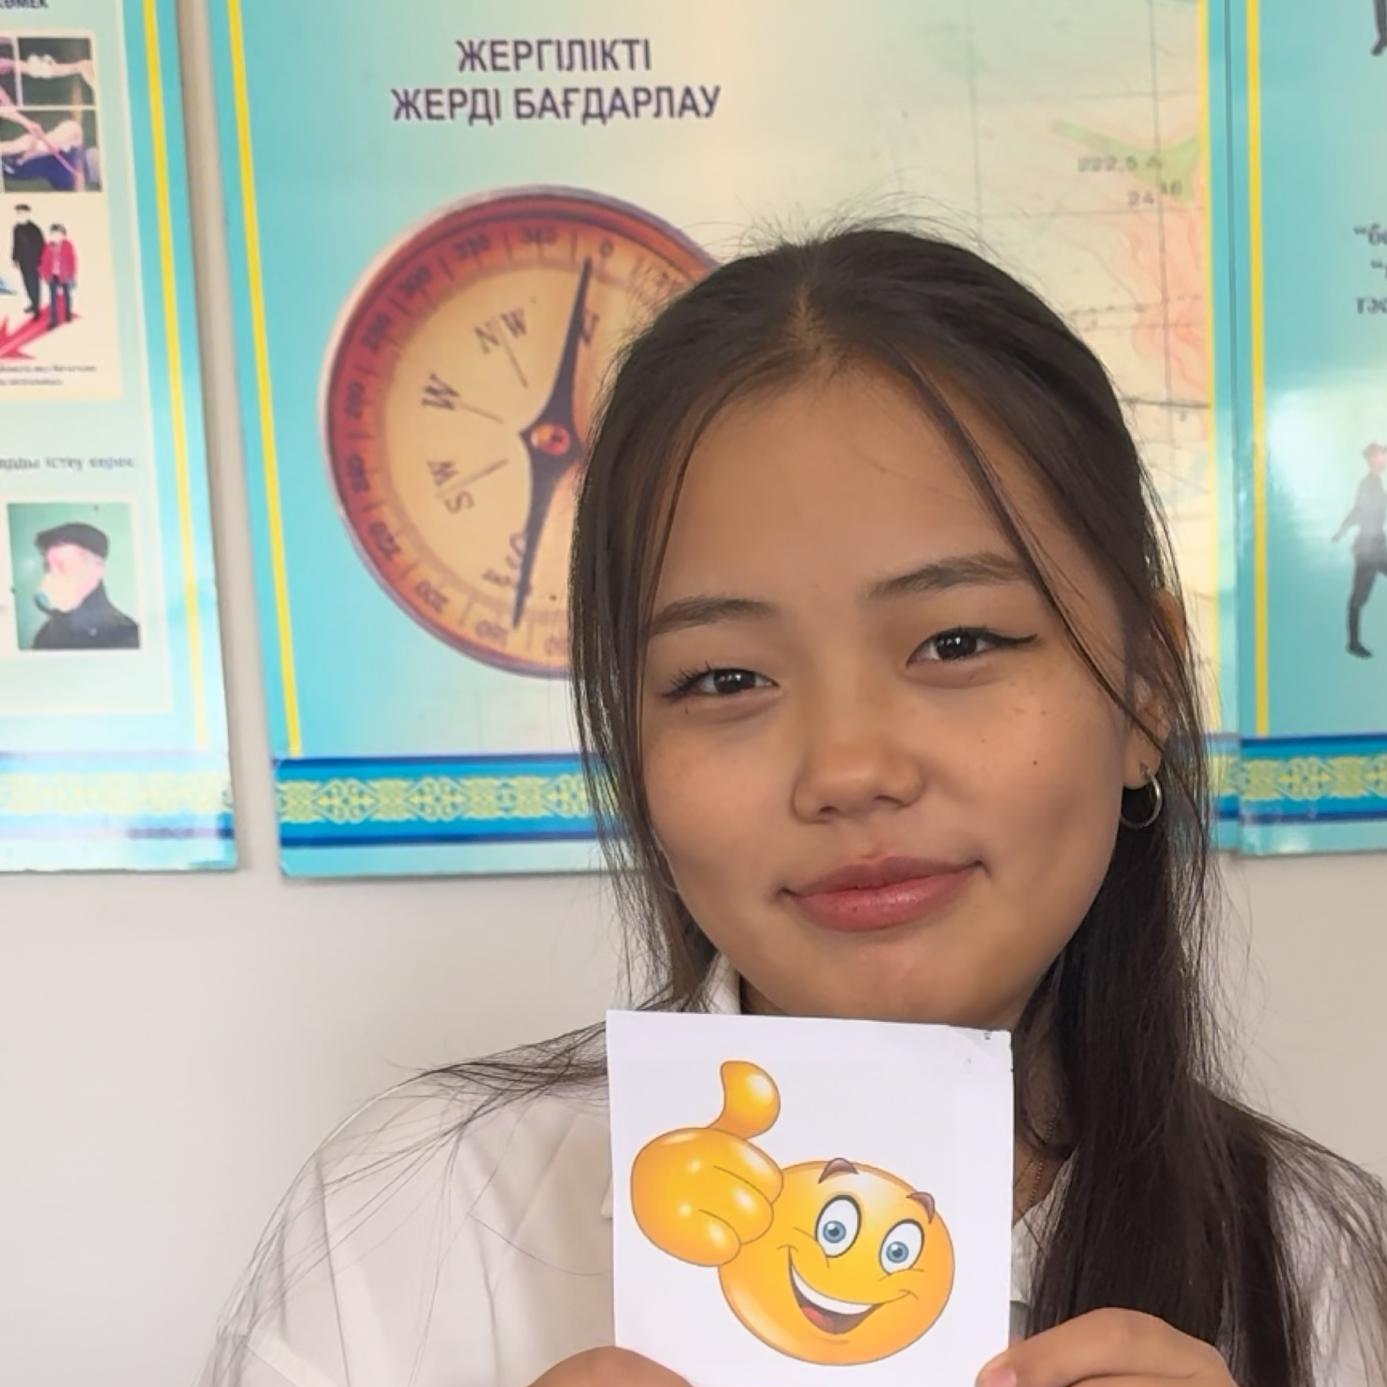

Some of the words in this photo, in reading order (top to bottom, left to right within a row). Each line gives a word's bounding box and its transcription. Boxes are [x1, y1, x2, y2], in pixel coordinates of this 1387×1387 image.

[456, 38, 652, 72] ЖЕРГІЛІКТІ
[391, 88, 502, 126] ЖЕРДІ
[514, 85, 721, 126] БАҒДАРЛАУ
